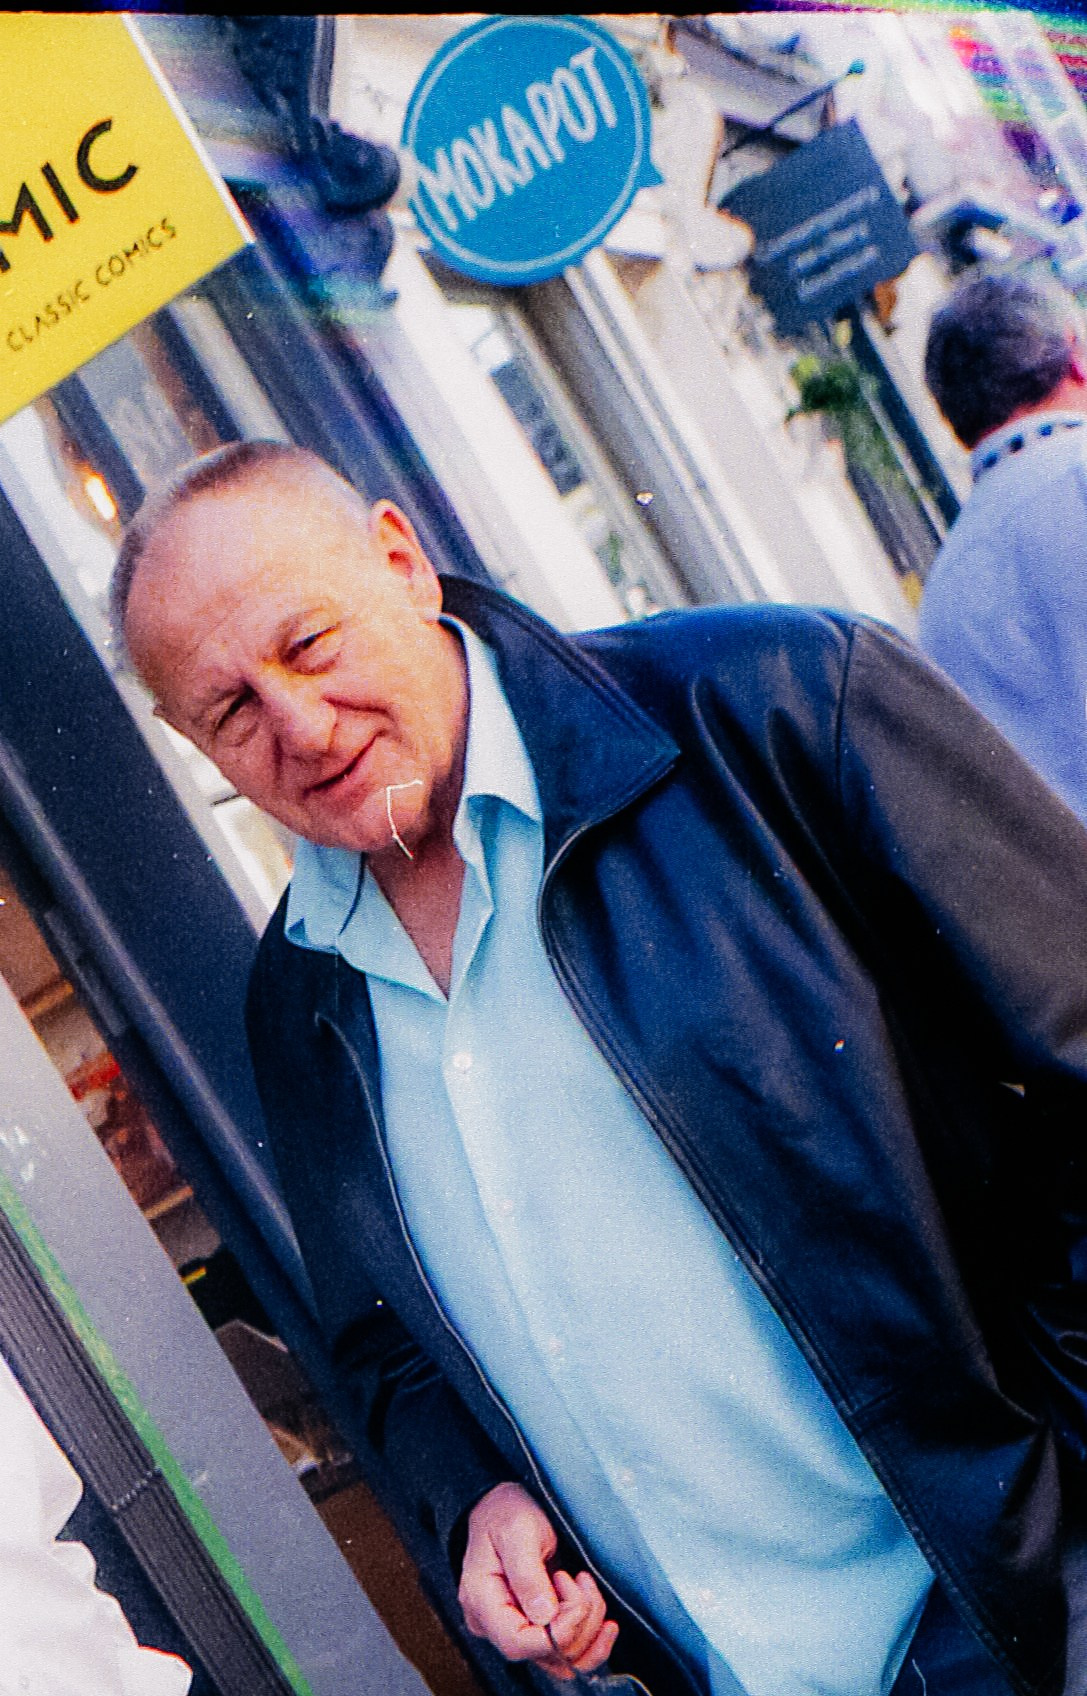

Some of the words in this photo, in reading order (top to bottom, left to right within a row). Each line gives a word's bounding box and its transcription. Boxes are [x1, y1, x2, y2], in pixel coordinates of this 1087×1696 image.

[417, 46, 618, 232] MOKAPOT
[6, 277, 91, 354] CLASSIC
[94, 216, 178, 288] COMICS
